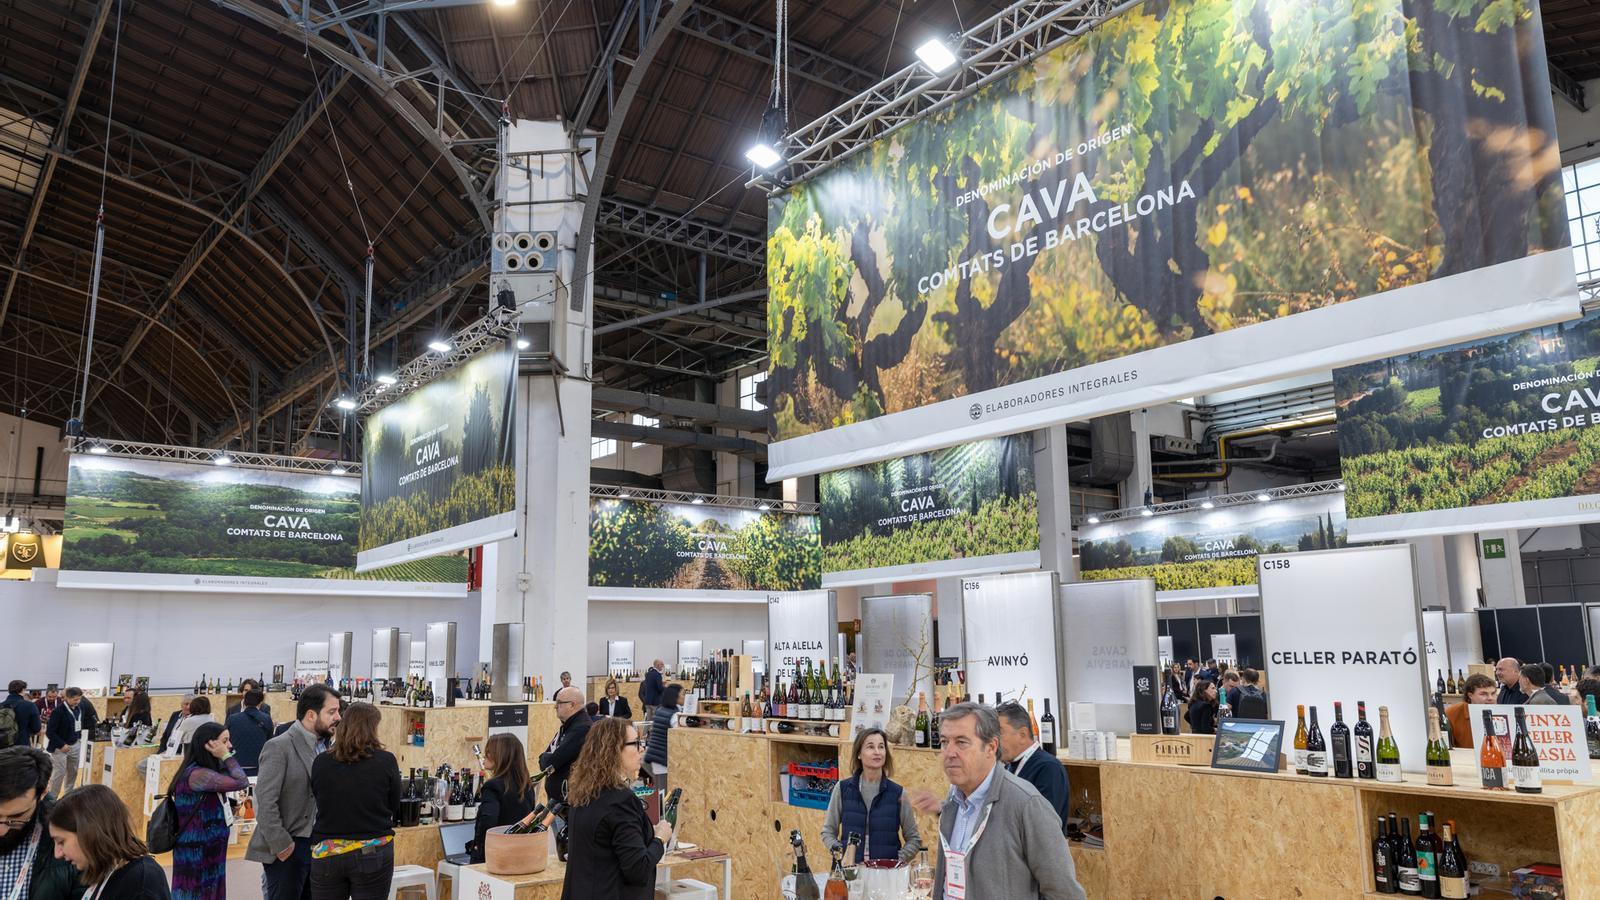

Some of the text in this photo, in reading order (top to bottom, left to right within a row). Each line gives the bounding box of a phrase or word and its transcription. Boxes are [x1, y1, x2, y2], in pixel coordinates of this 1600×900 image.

[956, 123, 1132, 208] DENOMINACIÓN DE ORIGEN
[986, 171, 1098, 240] CAVA
[917, 180, 1196, 295] COMTATS DE BARCELONA
[1513, 370, 1594, 391] DENOMINACIÓN
[985, 369, 1139, 414] ELABORADORES INTEGRALES
[1541, 387, 1600, 414] CAV
[1482, 418, 1558, 439] COMTATS
[1562, 414, 1586, 428] DE
[416, 441, 440, 466] CAVA
[398, 455, 459, 486] COMTATS DE BARCELONA
[249, 504, 294, 512] DENOMINACIÓN
[901, 495, 935, 513] CAVA
[263, 515, 311, 529] CAVA
[878, 507, 961, 526] COMTATS DE BARCELONA
[226, 527, 344, 541] COMTATS DE BARCELONA
[698, 540, 728, 551] CAVA
[1204, 540, 1235, 551] CAVA
[714, 552, 747, 560] BARCELONA
[1184, 553, 1211, 561] COMTATS
[1220, 548, 1258, 558] BARCELONA
[1263, 559, 1290, 570] C158
[964, 582, 980, 590] C156
[774, 641, 823, 651] ALTA ALELLA
[987, 652, 1029, 666] AVINYÓ
[1271, 647, 1418, 665] CELLER PARATÓ
[1539, 747, 1577, 761] ASIA
